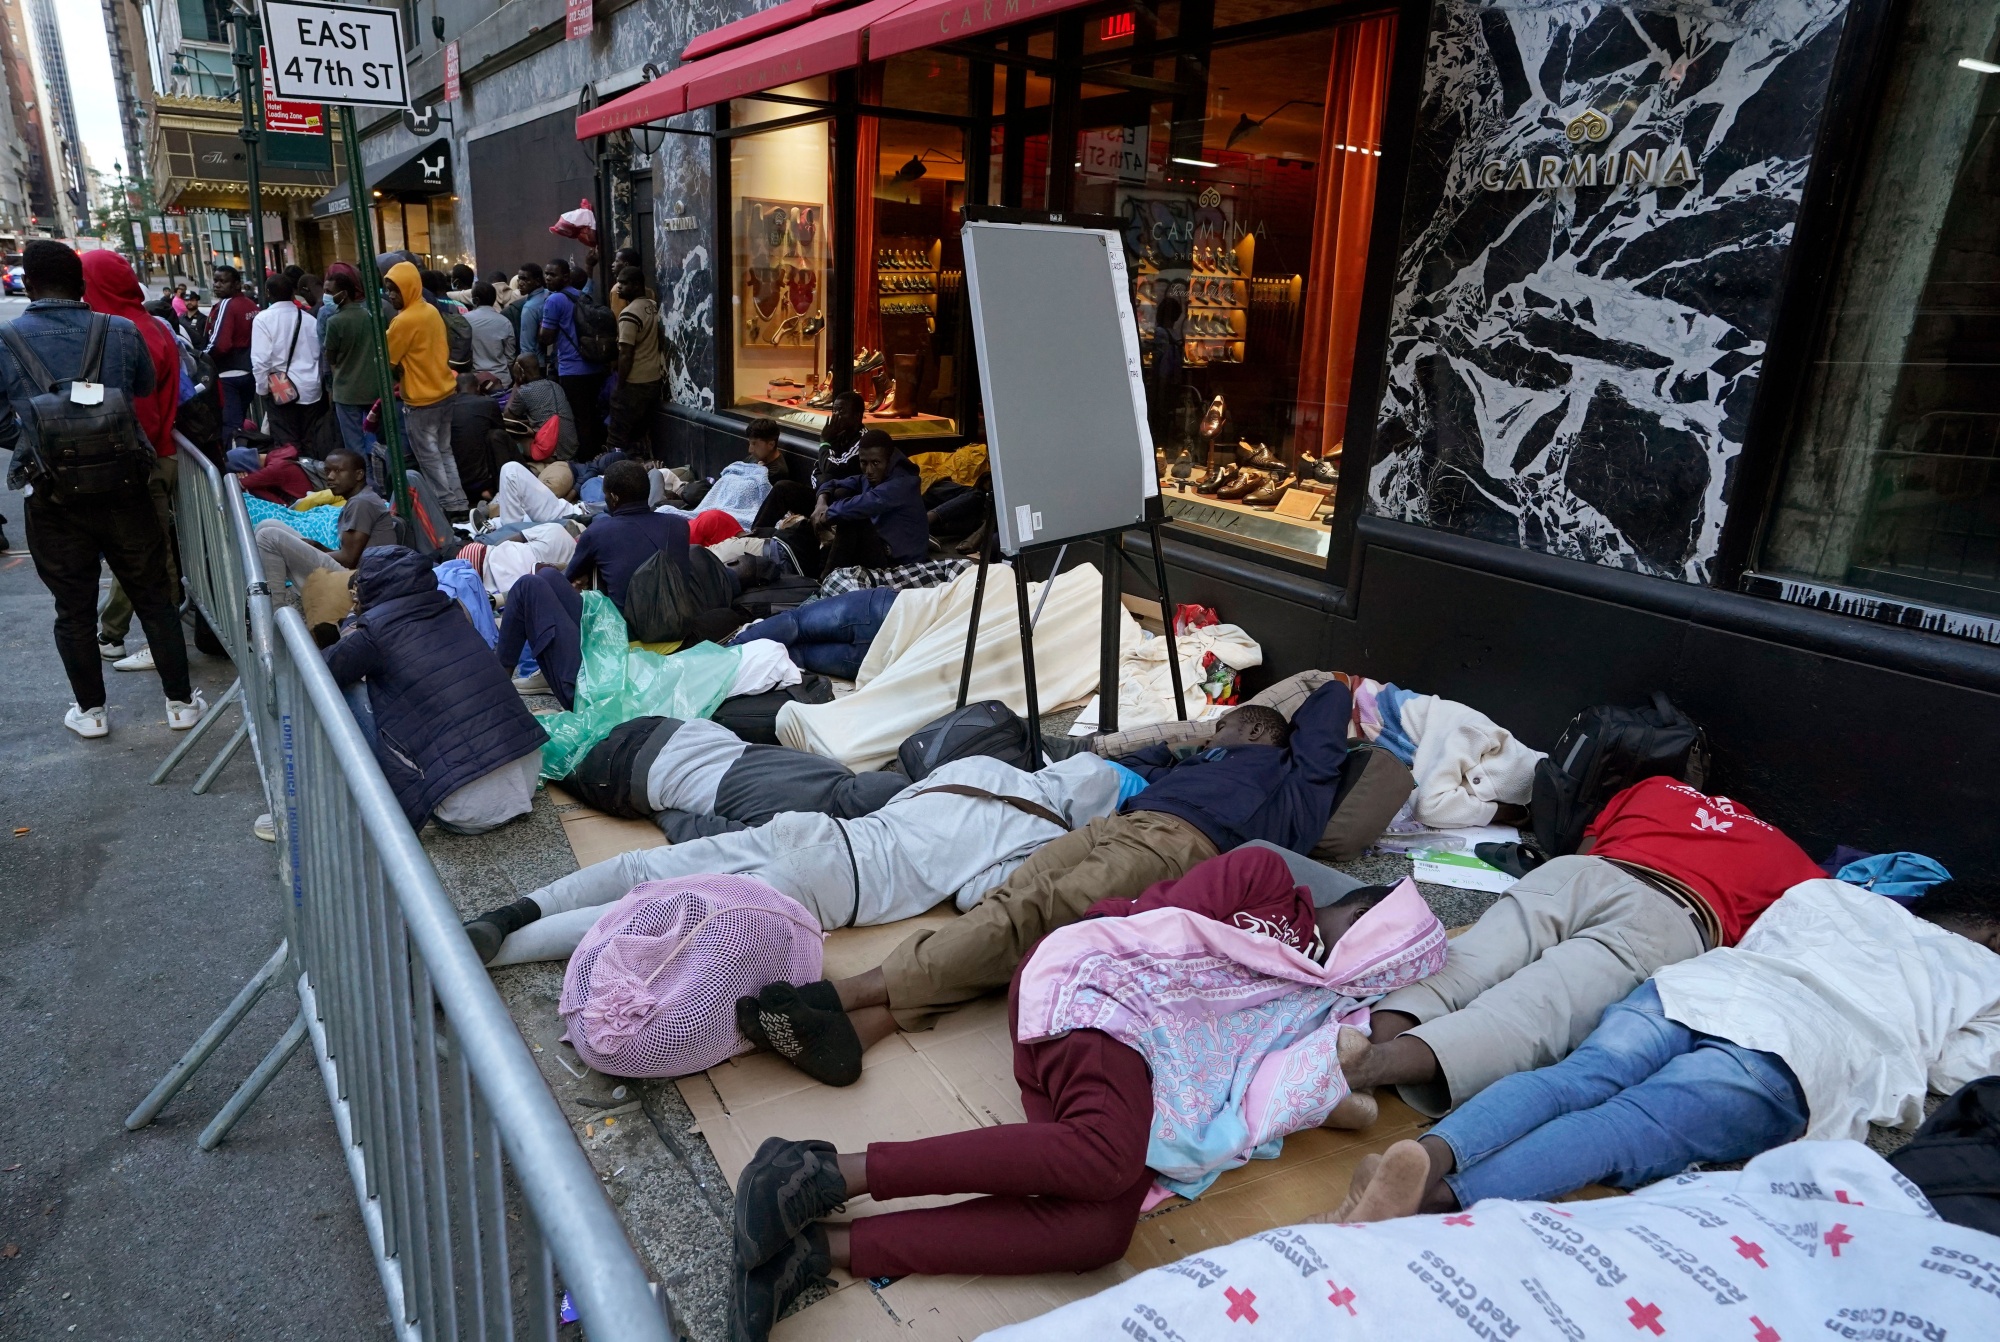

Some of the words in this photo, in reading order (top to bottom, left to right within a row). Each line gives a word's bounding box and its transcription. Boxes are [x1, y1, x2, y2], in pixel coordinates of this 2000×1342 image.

[297, 18, 371, 51] EAST
[284, 56, 354, 87] 47th
[362, 62, 394, 90] ST
[722, 62, 803, 93] CARMINA
[267, 103, 282, 111] Hotel
[267, 110, 289, 120] Loading
[289, 112, 303, 120] Zone
[601, 105, 650, 128] CARMINA
[202, 152, 228, 164] The
[1481, 146, 1696, 192] CARMINA
[1152, 220, 1267, 241] CARMINA
[282, 716, 293, 750] Long
[1530, 1211, 1584, 1244] Cross
[1635, 1224, 1698, 1264] Cross
[1190, 1257, 1229, 1279] Red
[1296, 1234, 1329, 1270] Red
[1520, 1219, 1614, 1288] American
[1582, 1244, 1628, 1284] Red
[1625, 1227, 1736, 1306] American
[1420, 1249, 1477, 1300] Cross
[1698, 1265, 1748, 1302] Red
[1475, 1297, 1521, 1339] Red
[1836, 1307, 1887, 1325] Cross
[1889, 1310, 1948, 1342] Red
